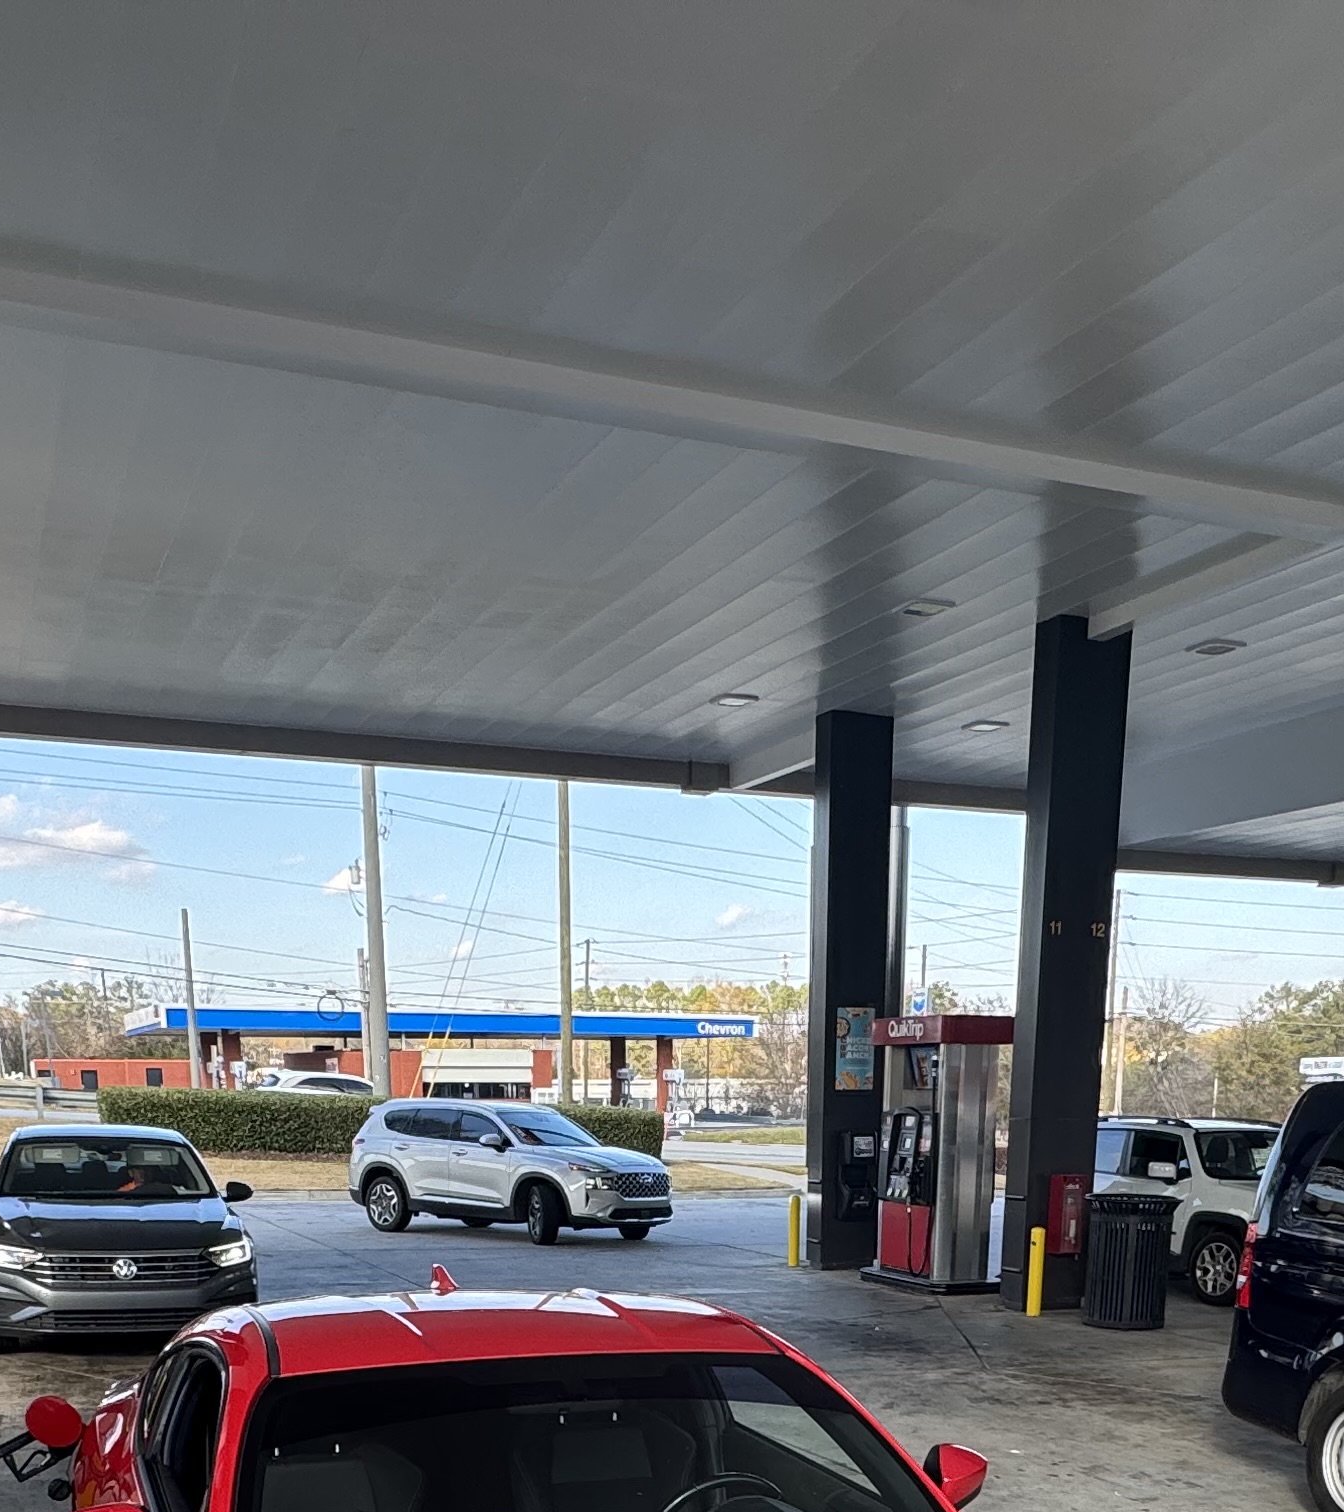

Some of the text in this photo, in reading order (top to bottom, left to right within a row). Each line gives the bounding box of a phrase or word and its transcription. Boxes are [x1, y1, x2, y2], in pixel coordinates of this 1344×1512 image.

[1049, 920, 1062, 936] 11
[1090, 922, 1106, 938] 12
[697, 1021, 745, 1036] Chevron
[888, 1019, 924, 1041] QuikTrip
